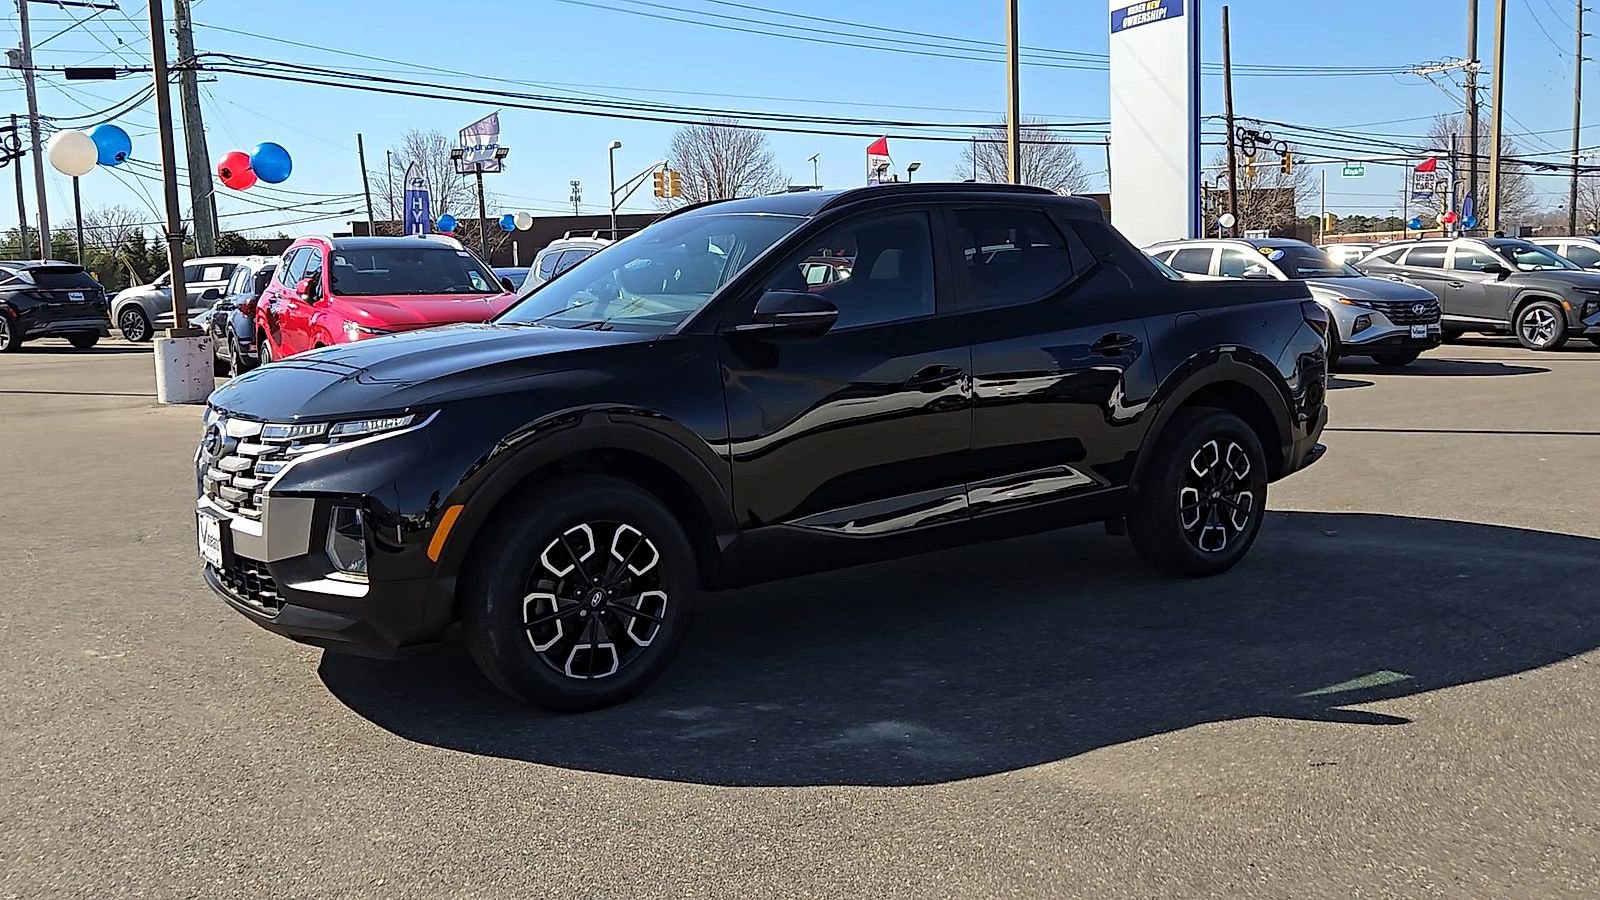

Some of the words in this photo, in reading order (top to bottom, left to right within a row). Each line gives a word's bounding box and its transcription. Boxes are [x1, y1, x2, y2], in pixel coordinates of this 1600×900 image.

[1122, 7, 1168, 28] OWNERSHIP!
[1415, 173, 1435, 182] USED
[1415, 182, 1435, 190] CARS
